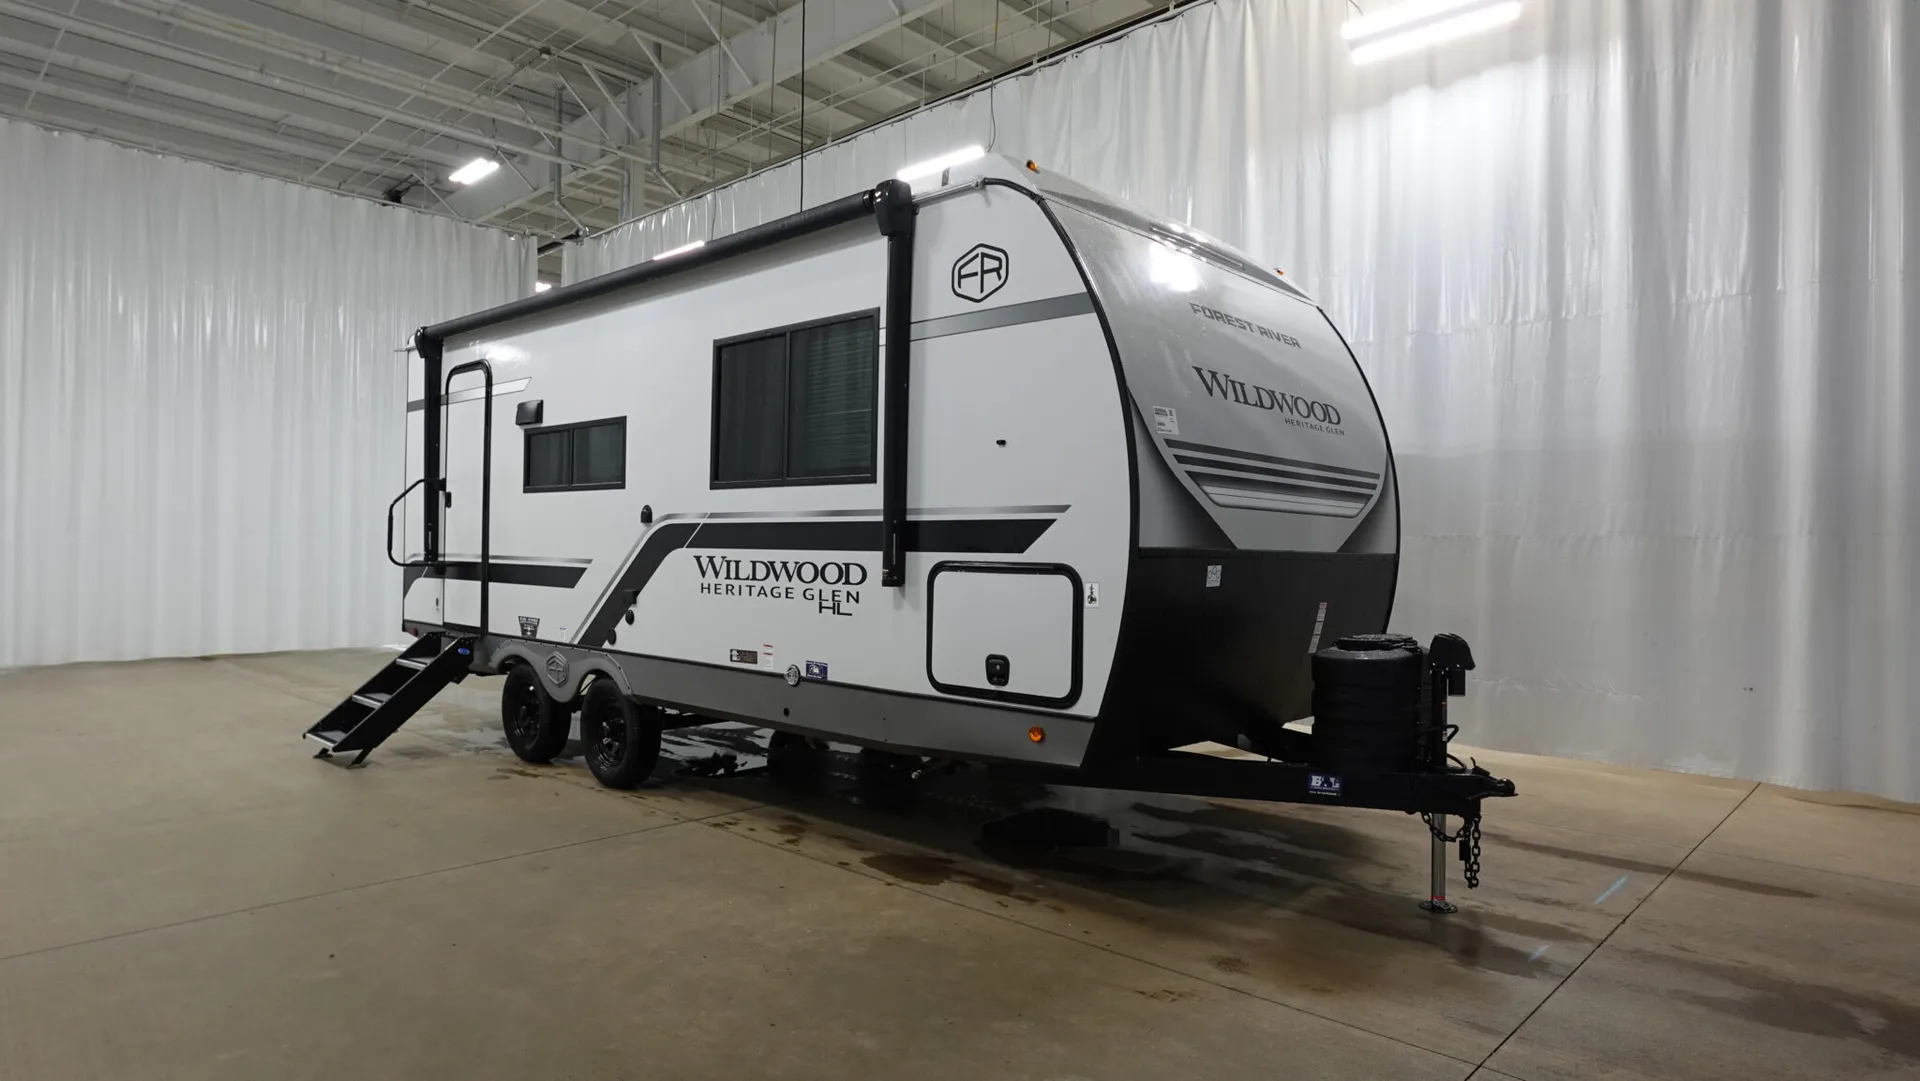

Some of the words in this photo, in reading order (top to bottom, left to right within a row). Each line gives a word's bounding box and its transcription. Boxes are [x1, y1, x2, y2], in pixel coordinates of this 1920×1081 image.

[1189, 302, 1254, 333] FOREST
[1257, 324, 1301, 348] RIVER
[1284, 417, 1325, 432] HERITAGE
[1325, 426, 1345, 436] GLEN
[700, 582, 795, 600] HERITAGE
[802, 588, 860, 604] GLEN
[818, 601, 853, 617] HL
